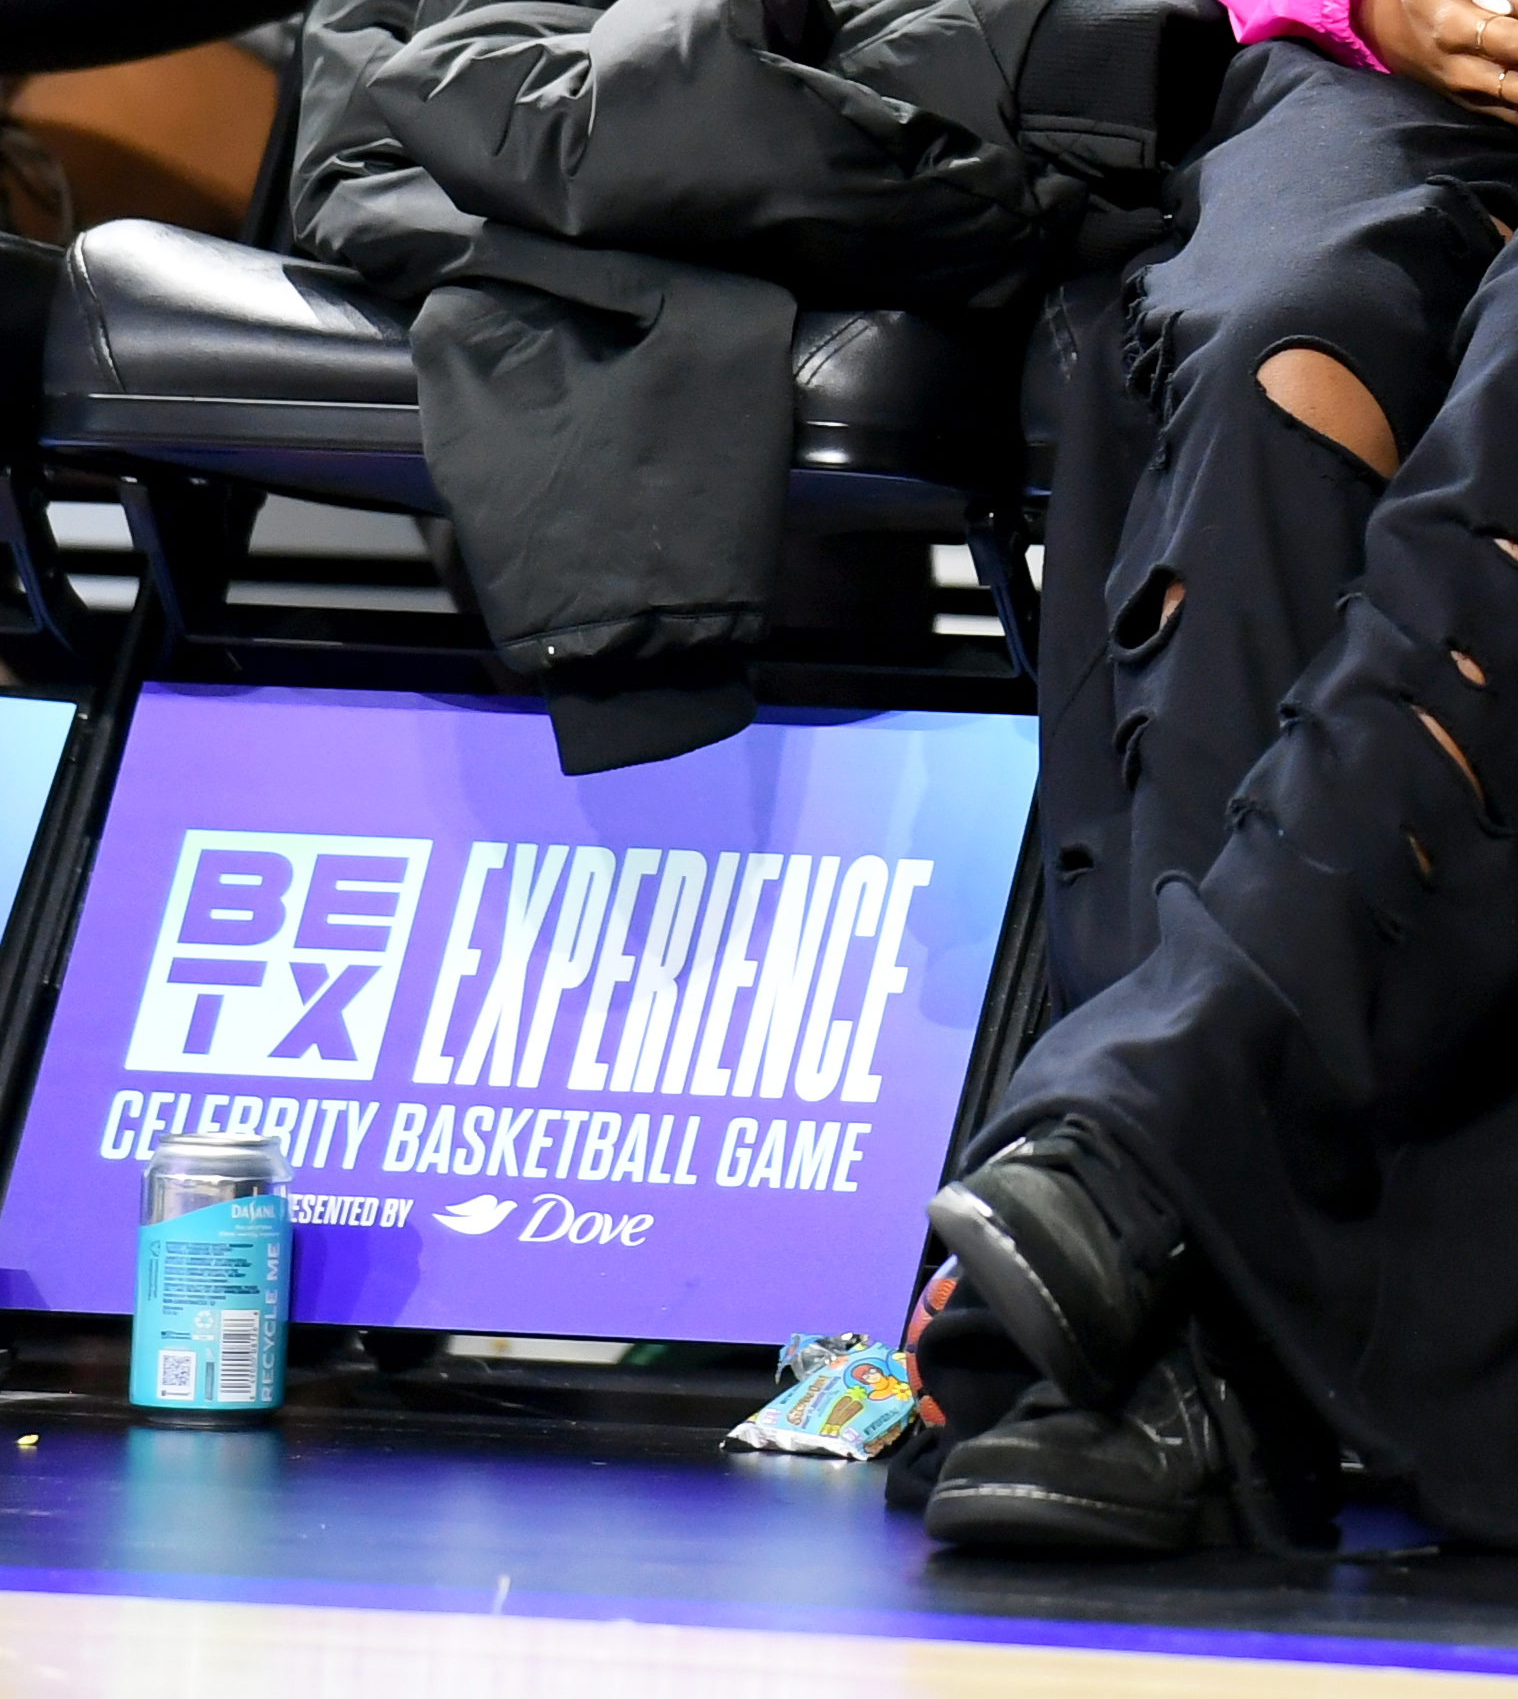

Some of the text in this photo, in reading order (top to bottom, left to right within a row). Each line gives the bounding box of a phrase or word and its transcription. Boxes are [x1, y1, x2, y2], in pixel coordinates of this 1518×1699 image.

[412, 840, 934, 1104] EXPERIENCE
[100, 1089, 872, 1194] CELEBRITY BASKETBALL GAME
[231, 1201, 276, 1222] DASANI
[379, 1198, 414, 1228] BY
[517, 1193, 655, 1246] Dove
[260, 1242, 281, 1402] RECYCLE ME
